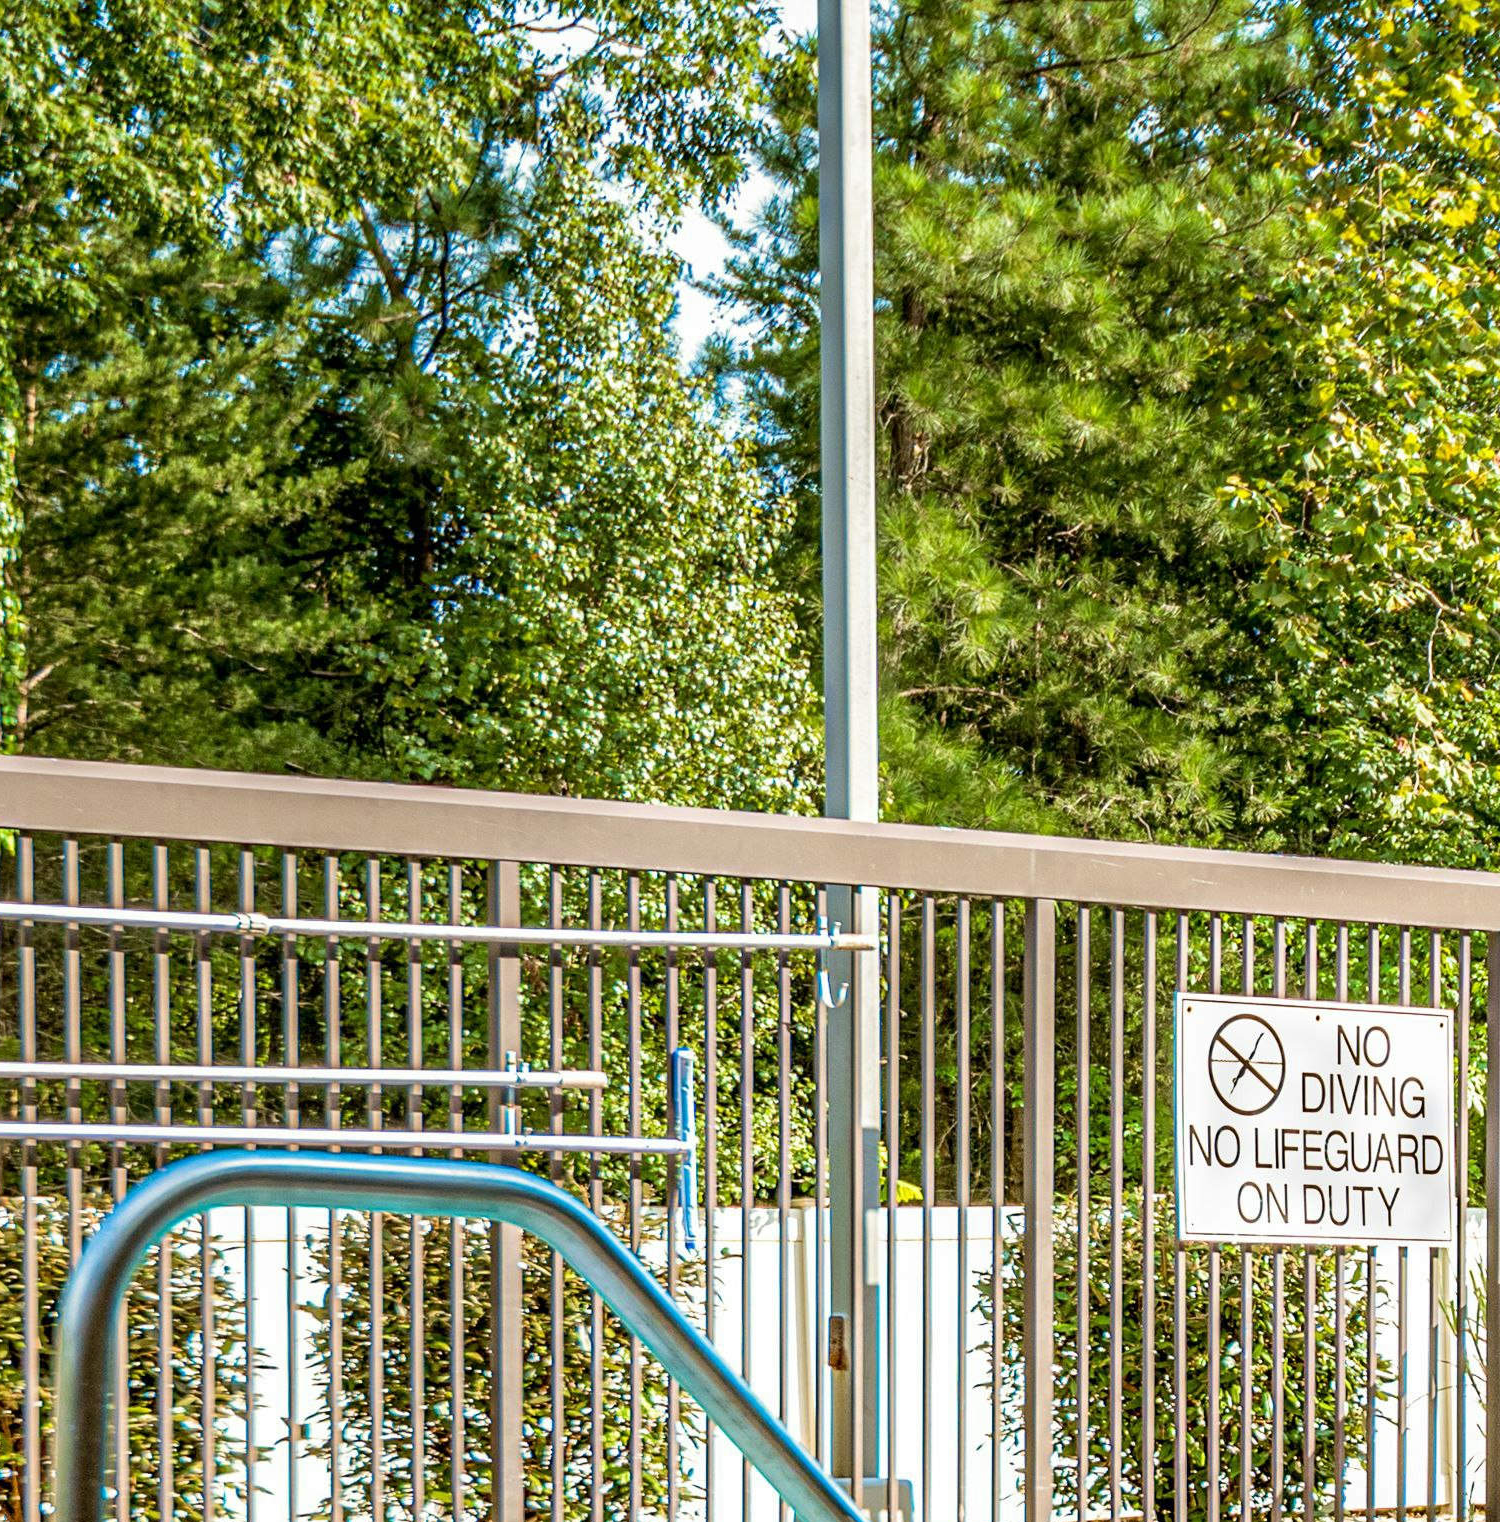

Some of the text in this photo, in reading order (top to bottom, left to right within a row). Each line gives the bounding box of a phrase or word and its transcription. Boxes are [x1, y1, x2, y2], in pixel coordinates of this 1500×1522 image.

[1337, 1025, 1391, 1067] NO
[1302, 1072, 1426, 1118] DIVING
[1189, 1124, 1444, 1175] NO LIFEGUARD
[1237, 1181, 1400, 1227] ON DUTY
